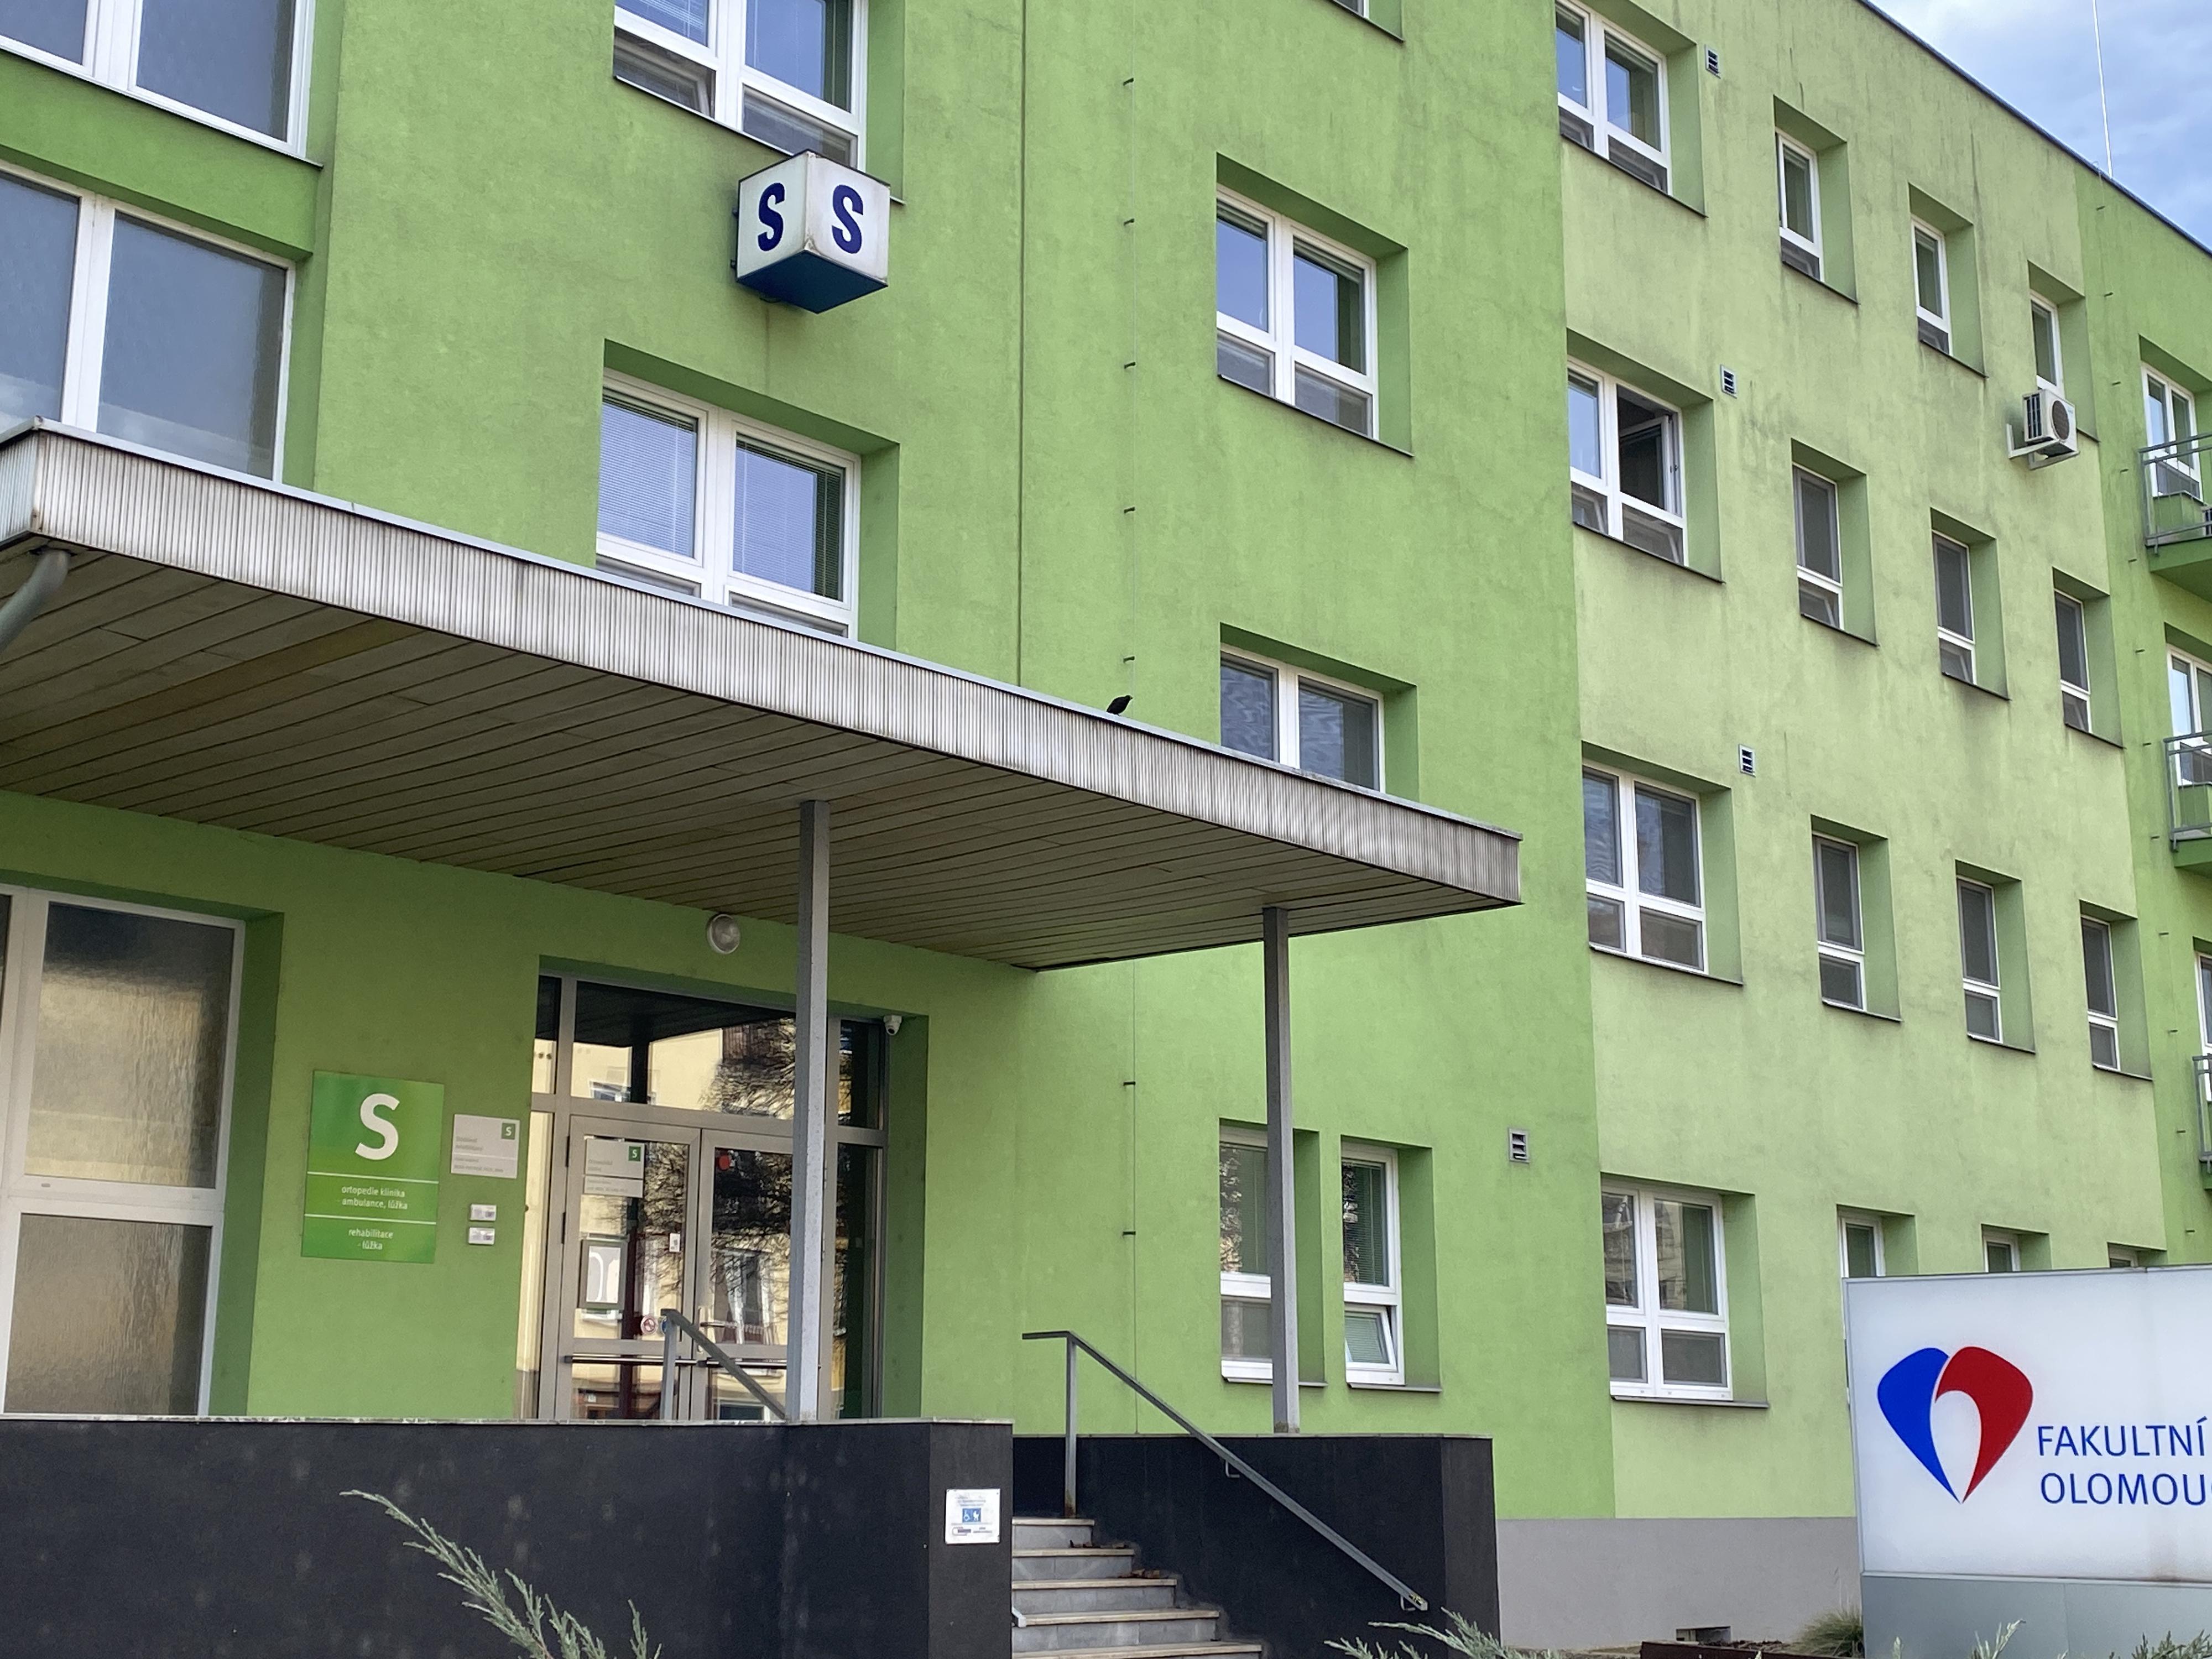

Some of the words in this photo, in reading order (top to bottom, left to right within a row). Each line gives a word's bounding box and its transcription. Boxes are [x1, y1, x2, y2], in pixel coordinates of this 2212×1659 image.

[758, 182, 785, 252] S
[831, 184, 864, 254] S
[355, 1093, 400, 1160] S
[505, 1126, 512, 1136] S
[632, 1149, 638, 1159] S
[342, 1186, 379, 1196] ortopedie
[380, 1188, 405, 1198] klinika
[342, 1198, 386, 1209] ambulance,
[348, 1228, 394, 1239] rehabilitace
[2038, 1416, 2208, 1456] FAKULTNÍ
[2041, 1473, 2212, 1506] OLOMOU
